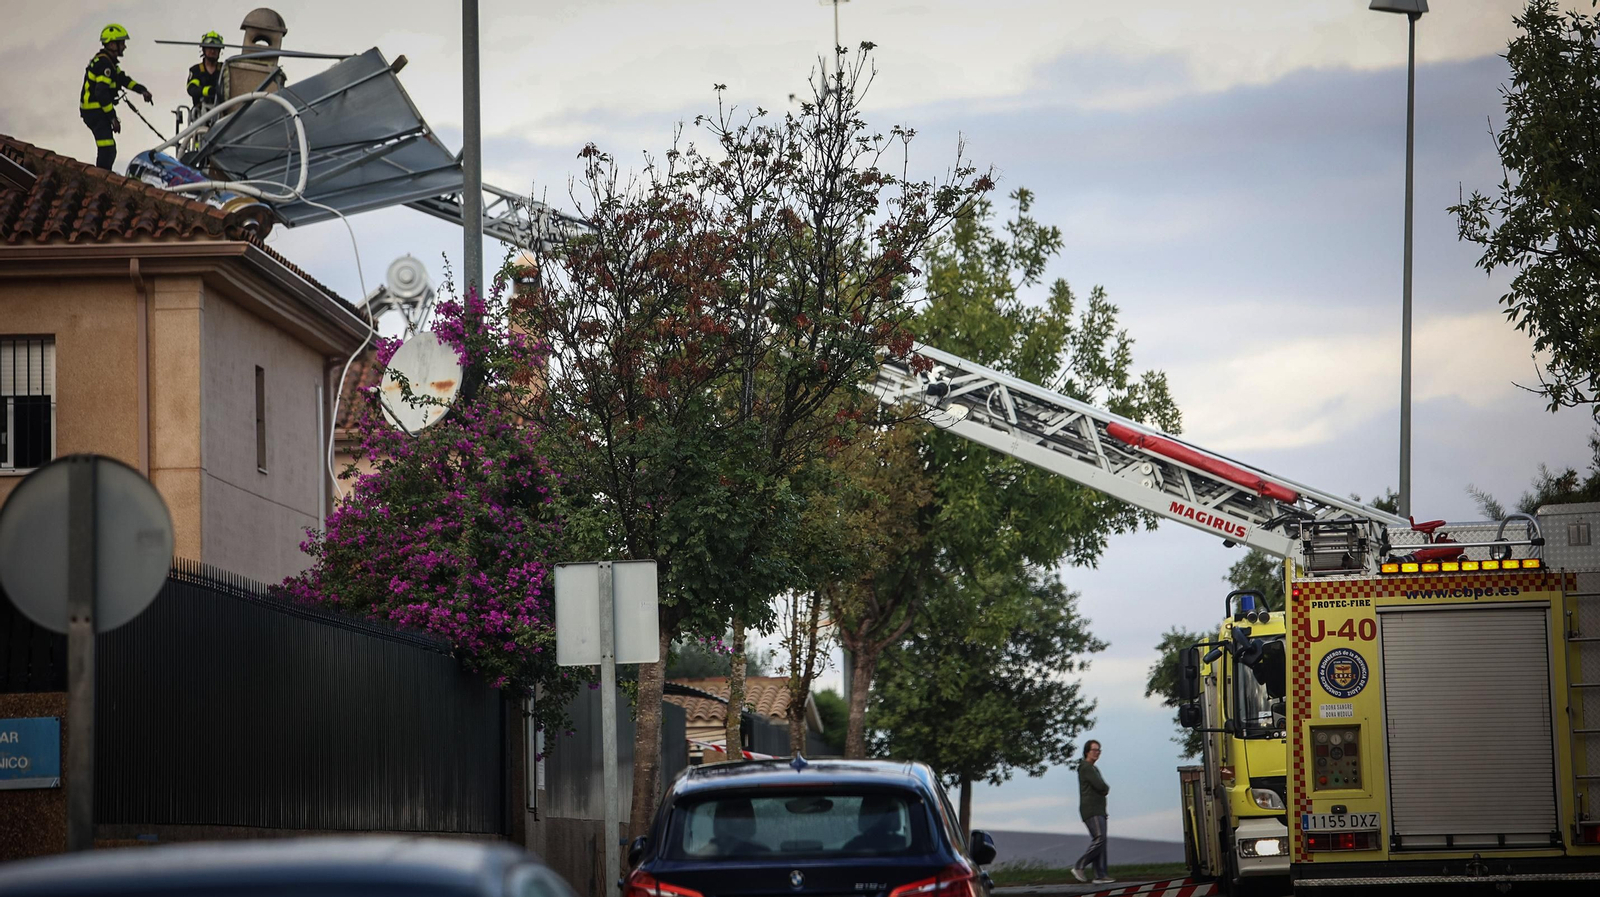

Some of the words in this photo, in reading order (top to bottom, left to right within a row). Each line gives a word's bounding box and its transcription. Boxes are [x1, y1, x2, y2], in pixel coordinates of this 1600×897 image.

[1169, 501, 1246, 538] MAGIRUS
[1405, 585, 1520, 600] www.cbpc.es
[1311, 599, 1371, 609] PROTEC-FIRE
[1304, 618, 1377, 643] U-40
[1321, 650, 1342, 669] BOMBEROS
[1354, 655, 1367, 679] PROVINCIA
[1320, 676, 1341, 697] CONSORCIO
[1312, 815, 1346, 829] 1155
[1350, 814, 1377, 828] DXZ
